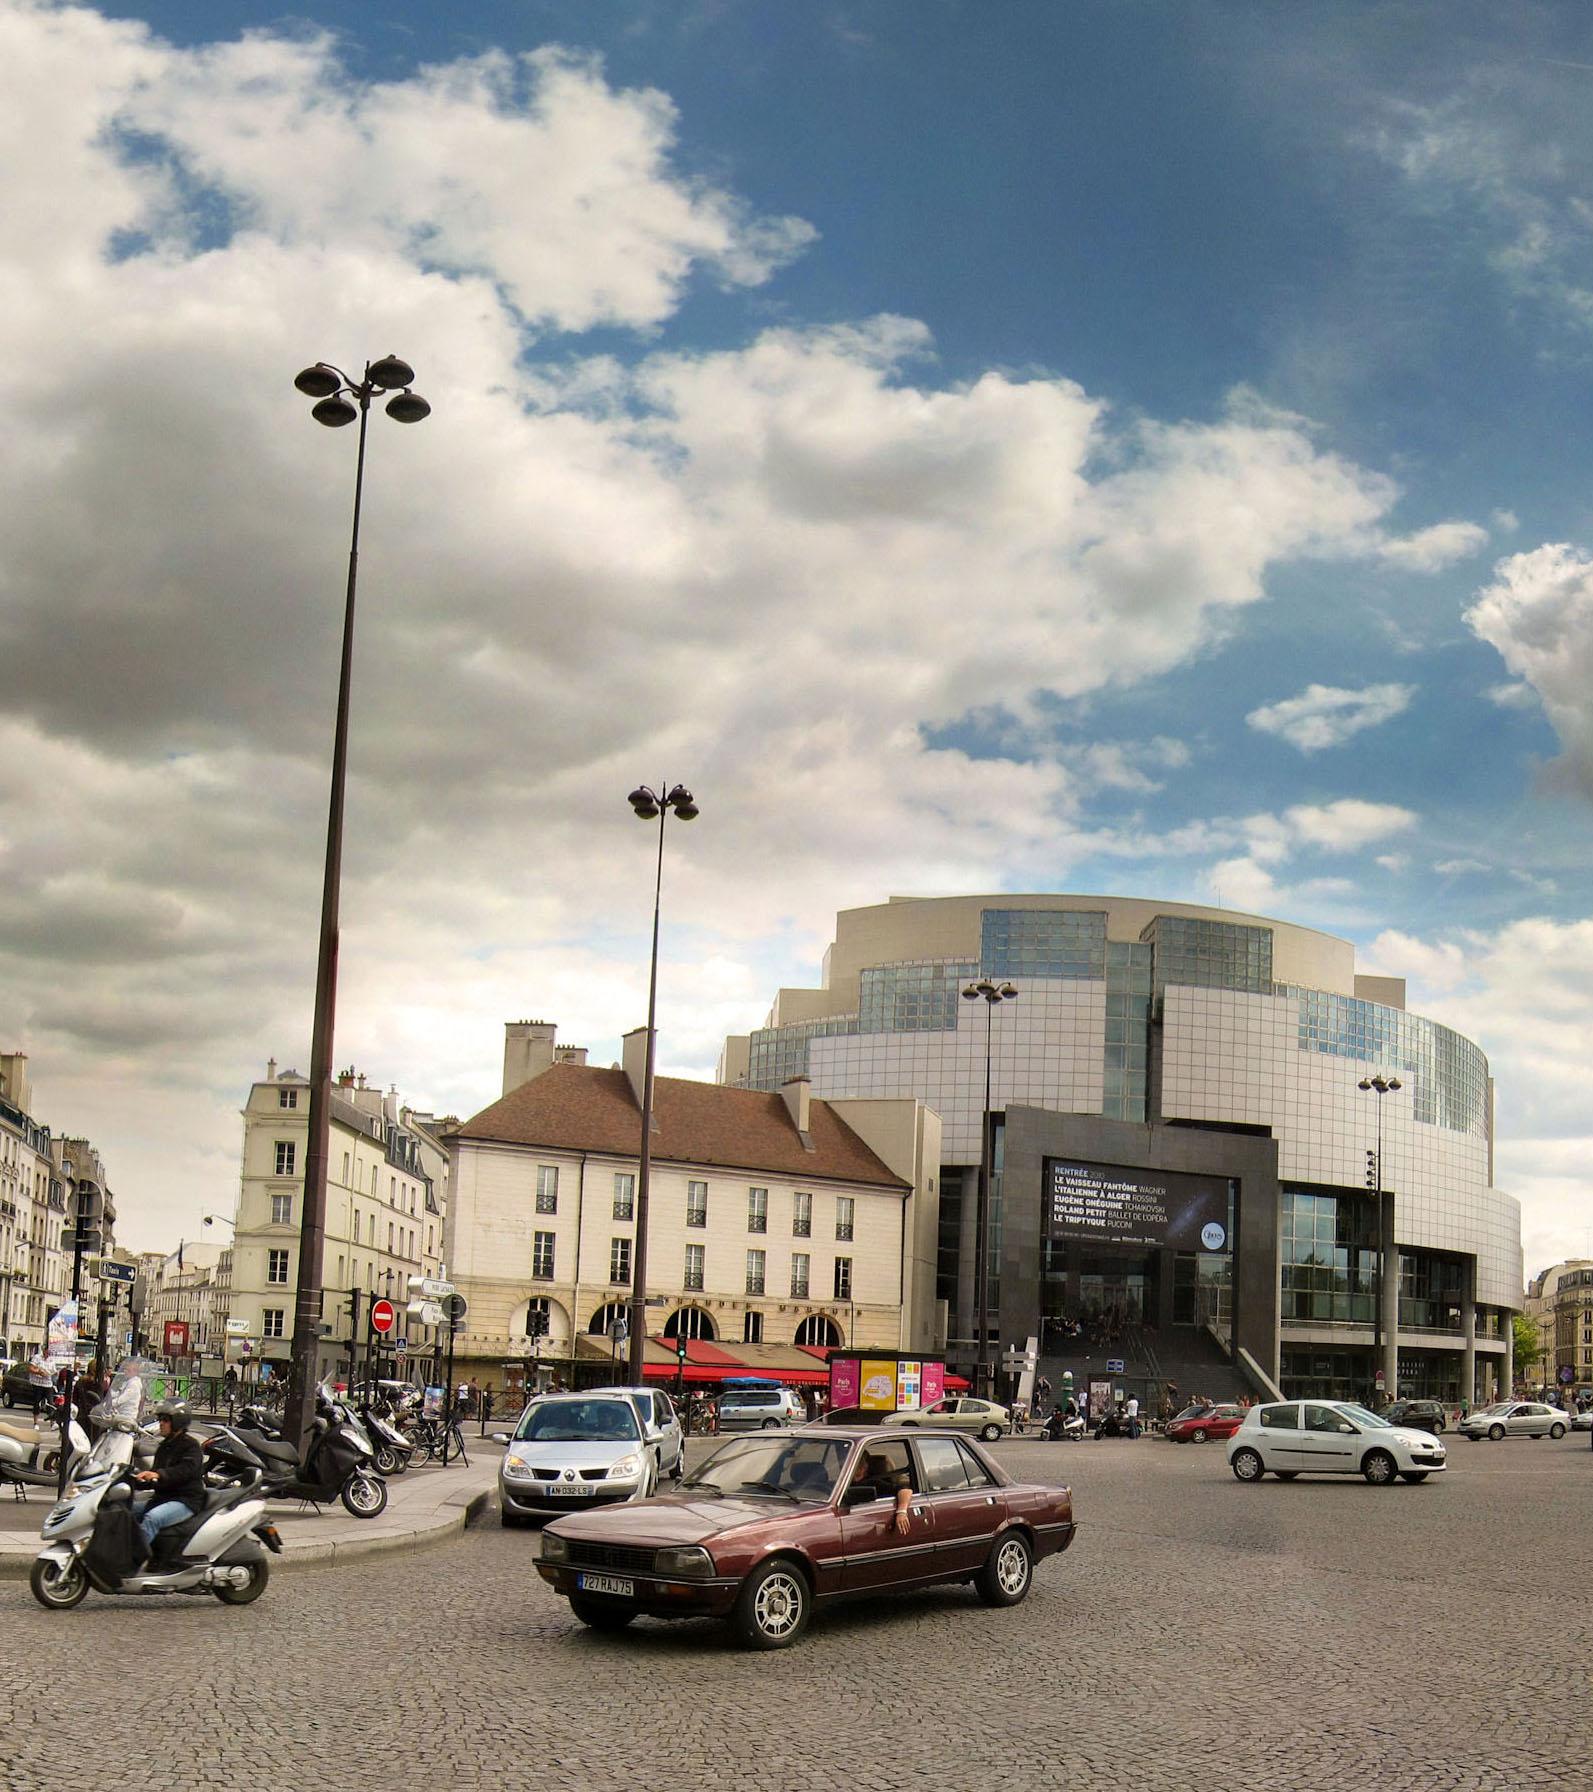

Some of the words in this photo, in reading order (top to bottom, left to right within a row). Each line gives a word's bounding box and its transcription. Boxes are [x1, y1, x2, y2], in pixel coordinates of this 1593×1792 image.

[1054, 1166, 1089, 1177] RENTRÉE
[1054, 1175, 1064, 1184] LE
[1065, 1176, 1101, 1189] VAISSEAU
[1103, 1181, 1138, 1192] FANTÔME
[1139, 1186, 1166, 1195] WAGNER
[1054, 1185, 1098, 1198] L'ITALIENNE
[1106, 1191, 1131, 1201] ALGER
[1132, 1194, 1158, 1204] ROSSINI
[1054, 1195, 1085, 1205] EUGÈNE
[1085, 1198, 1123, 1210] ONÉGUINE
[1054, 1204, 1085, 1215] ROLAND
[1086, 1208, 1107, 1217] PETIT
[1108, 1209, 1131, 1219] BALLET
[1132, 1212, 1141, 1220] DE
[1054, 1214, 1063, 1222] LE
[1065, 1215, 1106, 1227] TRIPTYQUE
[1107, 1218, 1133, 1229] PUCCINI
